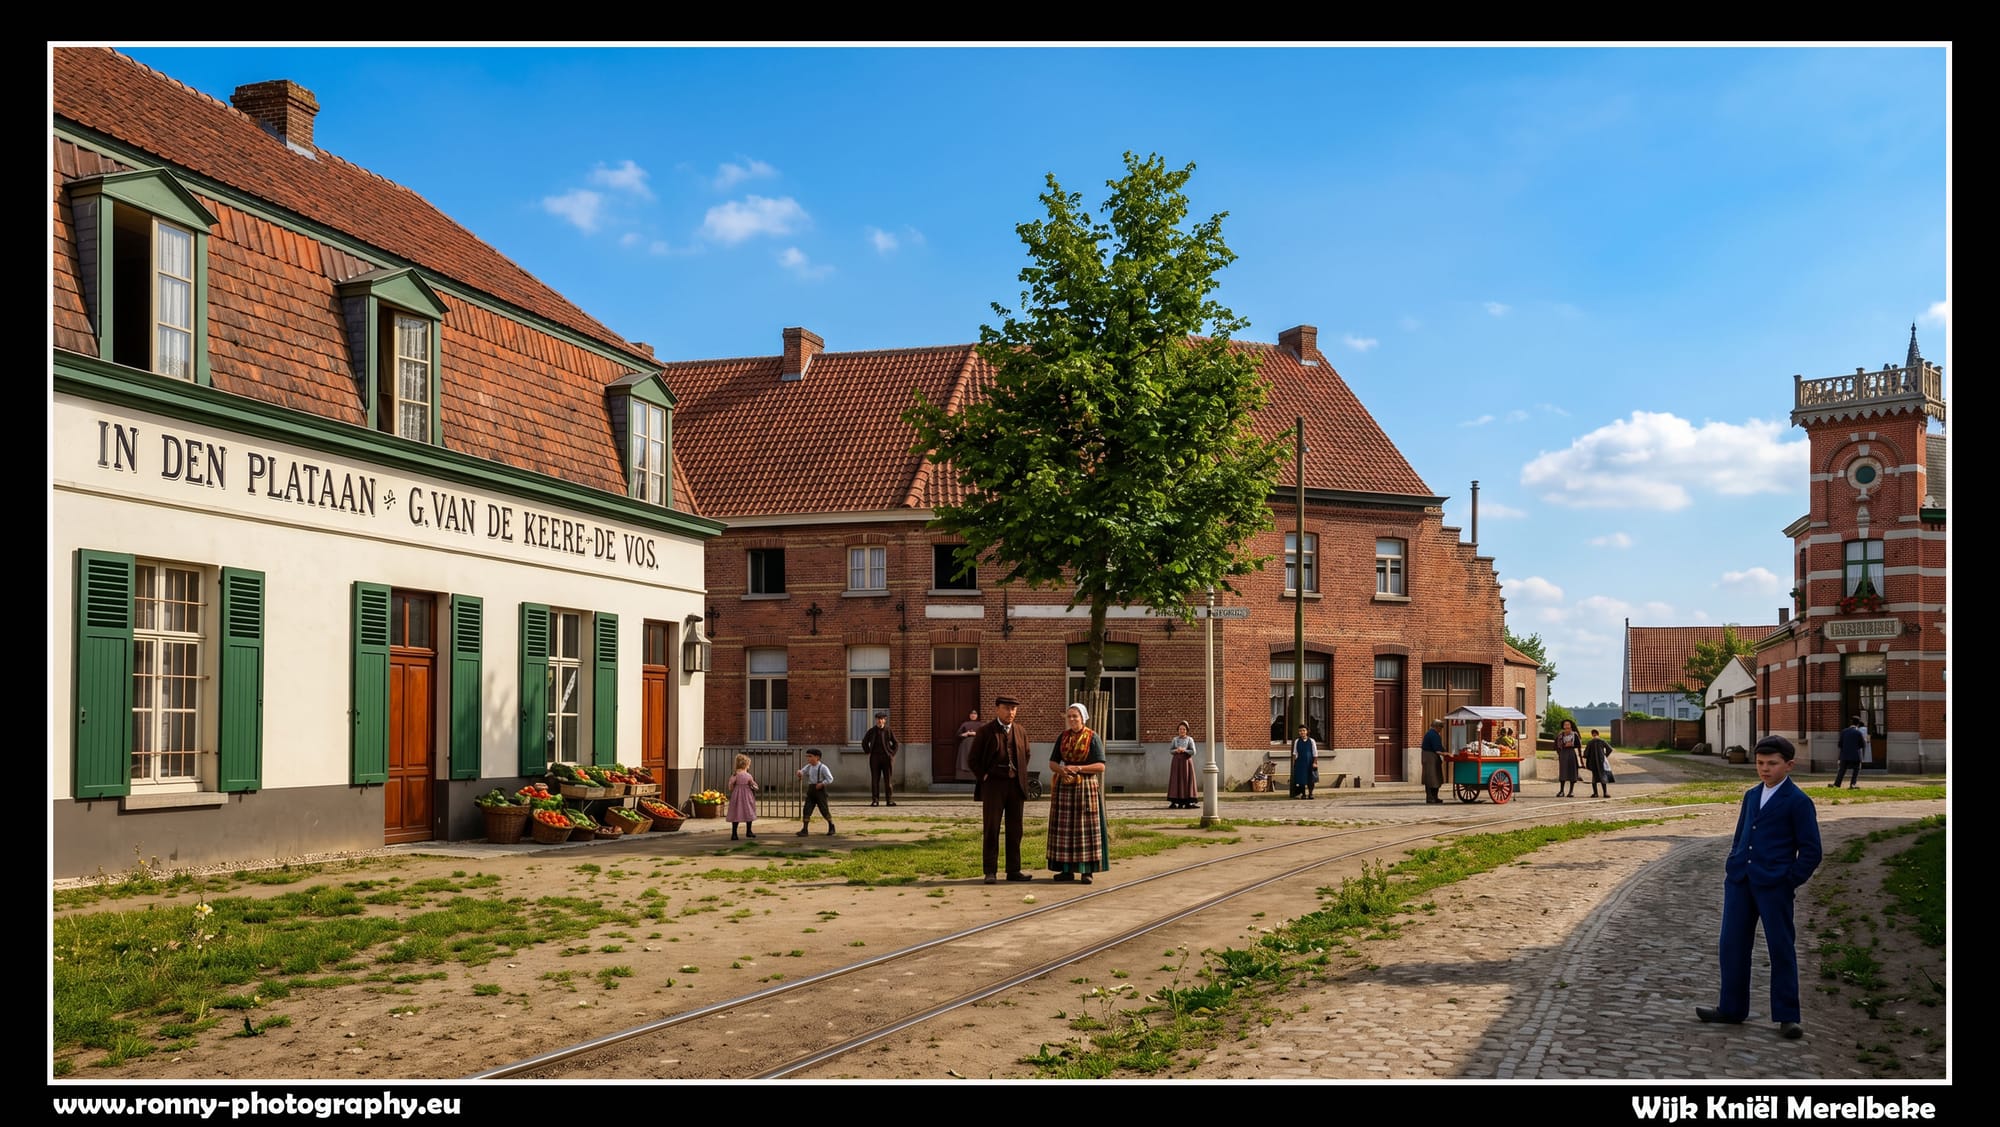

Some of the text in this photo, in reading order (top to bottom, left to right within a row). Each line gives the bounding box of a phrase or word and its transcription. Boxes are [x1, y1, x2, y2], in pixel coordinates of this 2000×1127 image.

[98, 420, 138, 472] IN
[161, 433, 227, 489] DEN
[247, 451, 376, 516] PLATAAN
[487, 503, 514, 541] DE
[623, 533, 660, 569] VOS.
